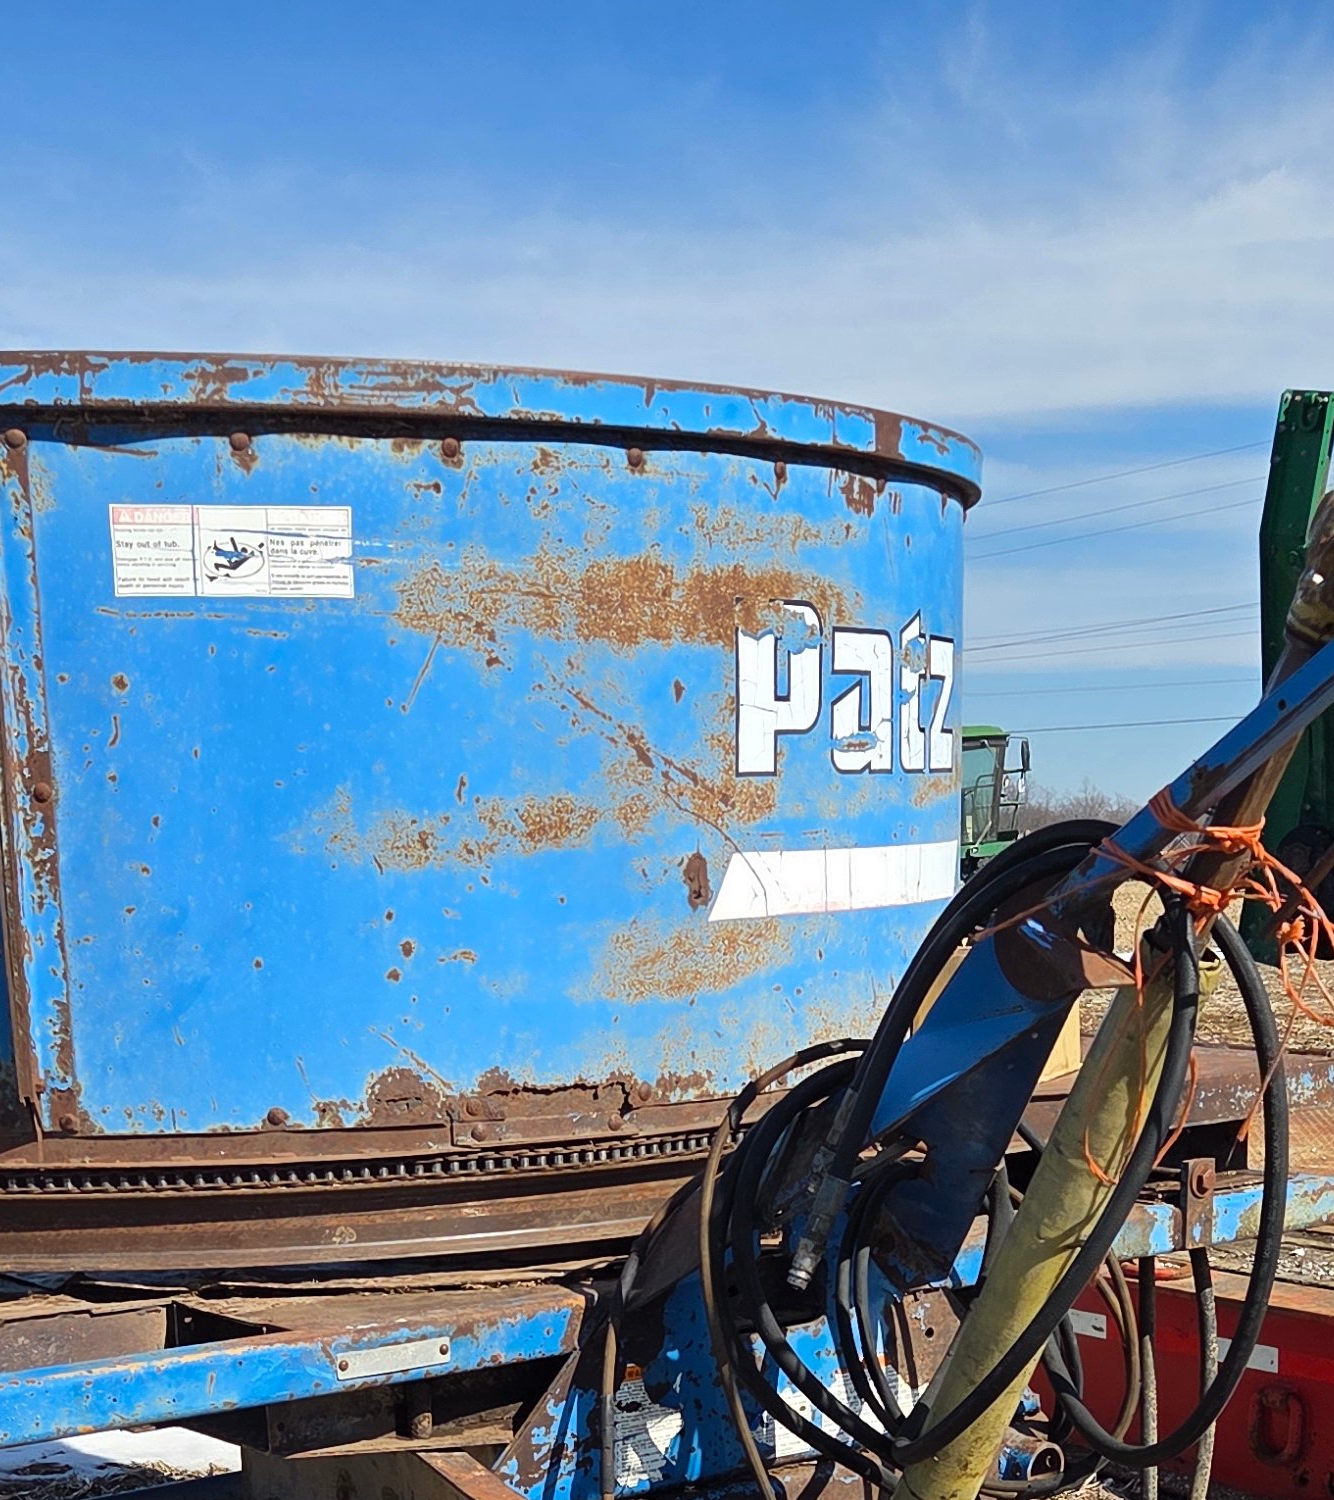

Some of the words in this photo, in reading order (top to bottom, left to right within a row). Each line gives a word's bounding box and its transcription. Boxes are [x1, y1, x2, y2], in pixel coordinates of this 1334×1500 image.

[116, 540, 133, 549] Stay
[153, 540, 162, 548] of
[270, 547, 288, 555] dans
[291, 547, 298, 555] la
[734, 597, 955, 777] Patz
